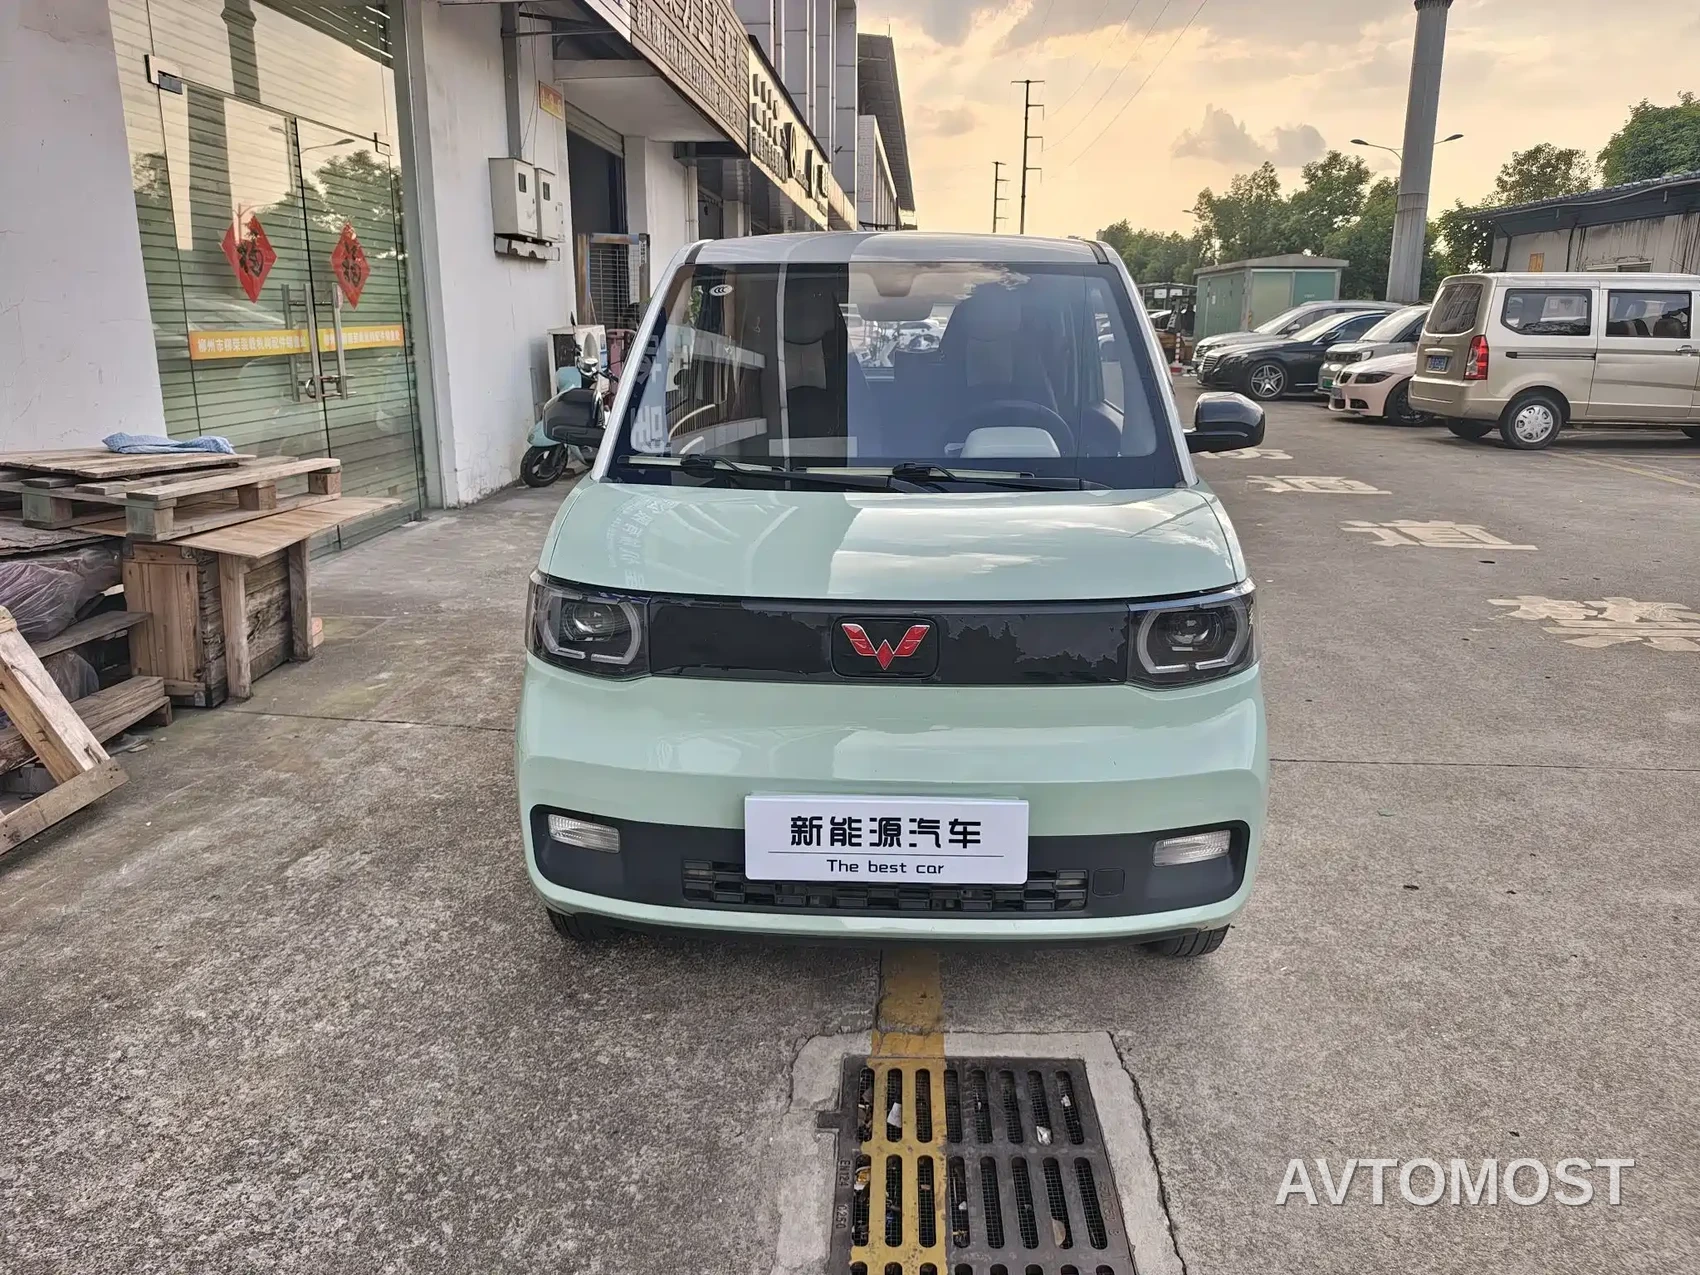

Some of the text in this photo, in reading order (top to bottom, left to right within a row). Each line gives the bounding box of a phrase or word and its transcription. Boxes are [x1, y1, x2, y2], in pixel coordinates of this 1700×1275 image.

[790, 815, 982, 849] 新能源汽车
[826, 859, 945, 875] The best car
